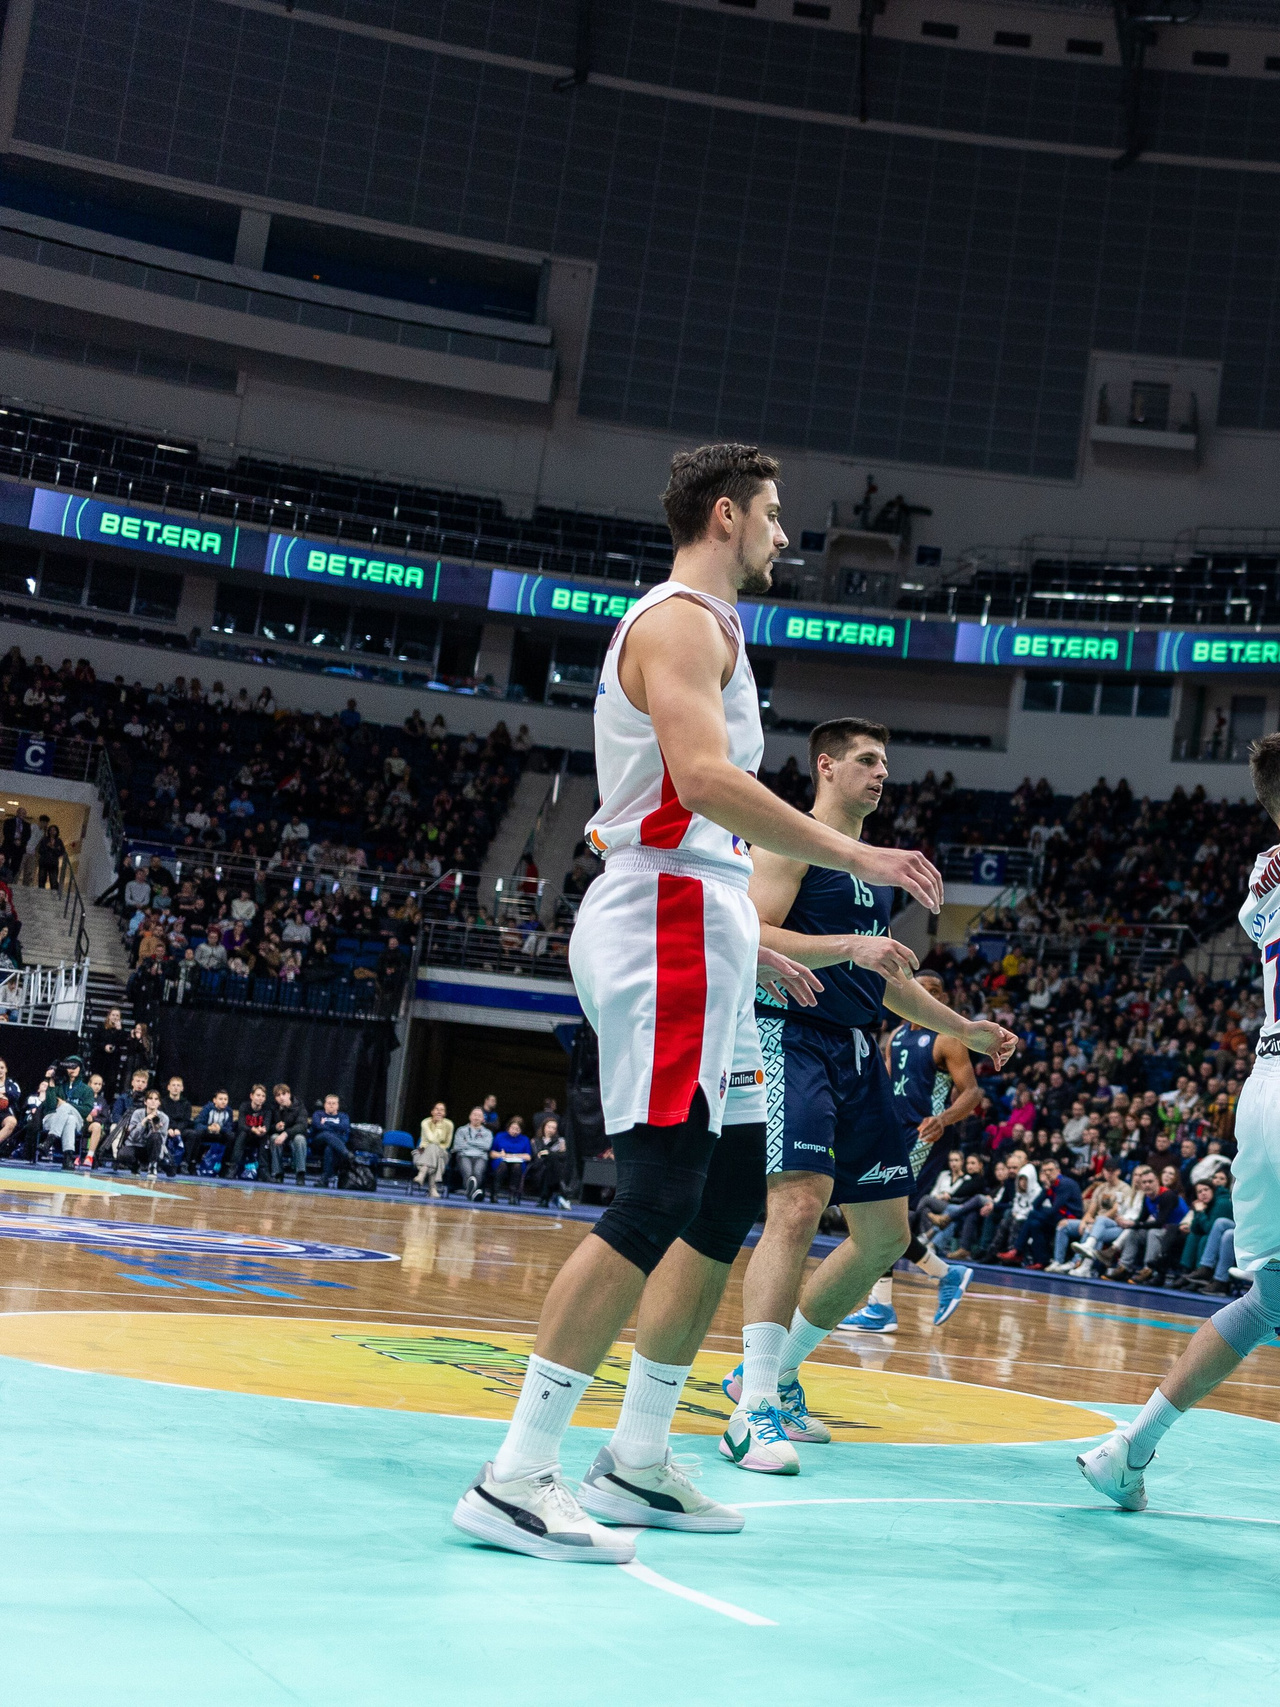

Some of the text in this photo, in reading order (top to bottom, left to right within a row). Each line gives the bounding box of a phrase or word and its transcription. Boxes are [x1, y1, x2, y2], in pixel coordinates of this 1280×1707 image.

[25, 745, 46, 768] C
[980, 860, 998, 881] C
[898, 1049, 909, 1070] 3
[730, 1073, 754, 1086] inline
[794, 1140, 827, 1154] Kempa
[542, 1391, 550, 1400] 8
